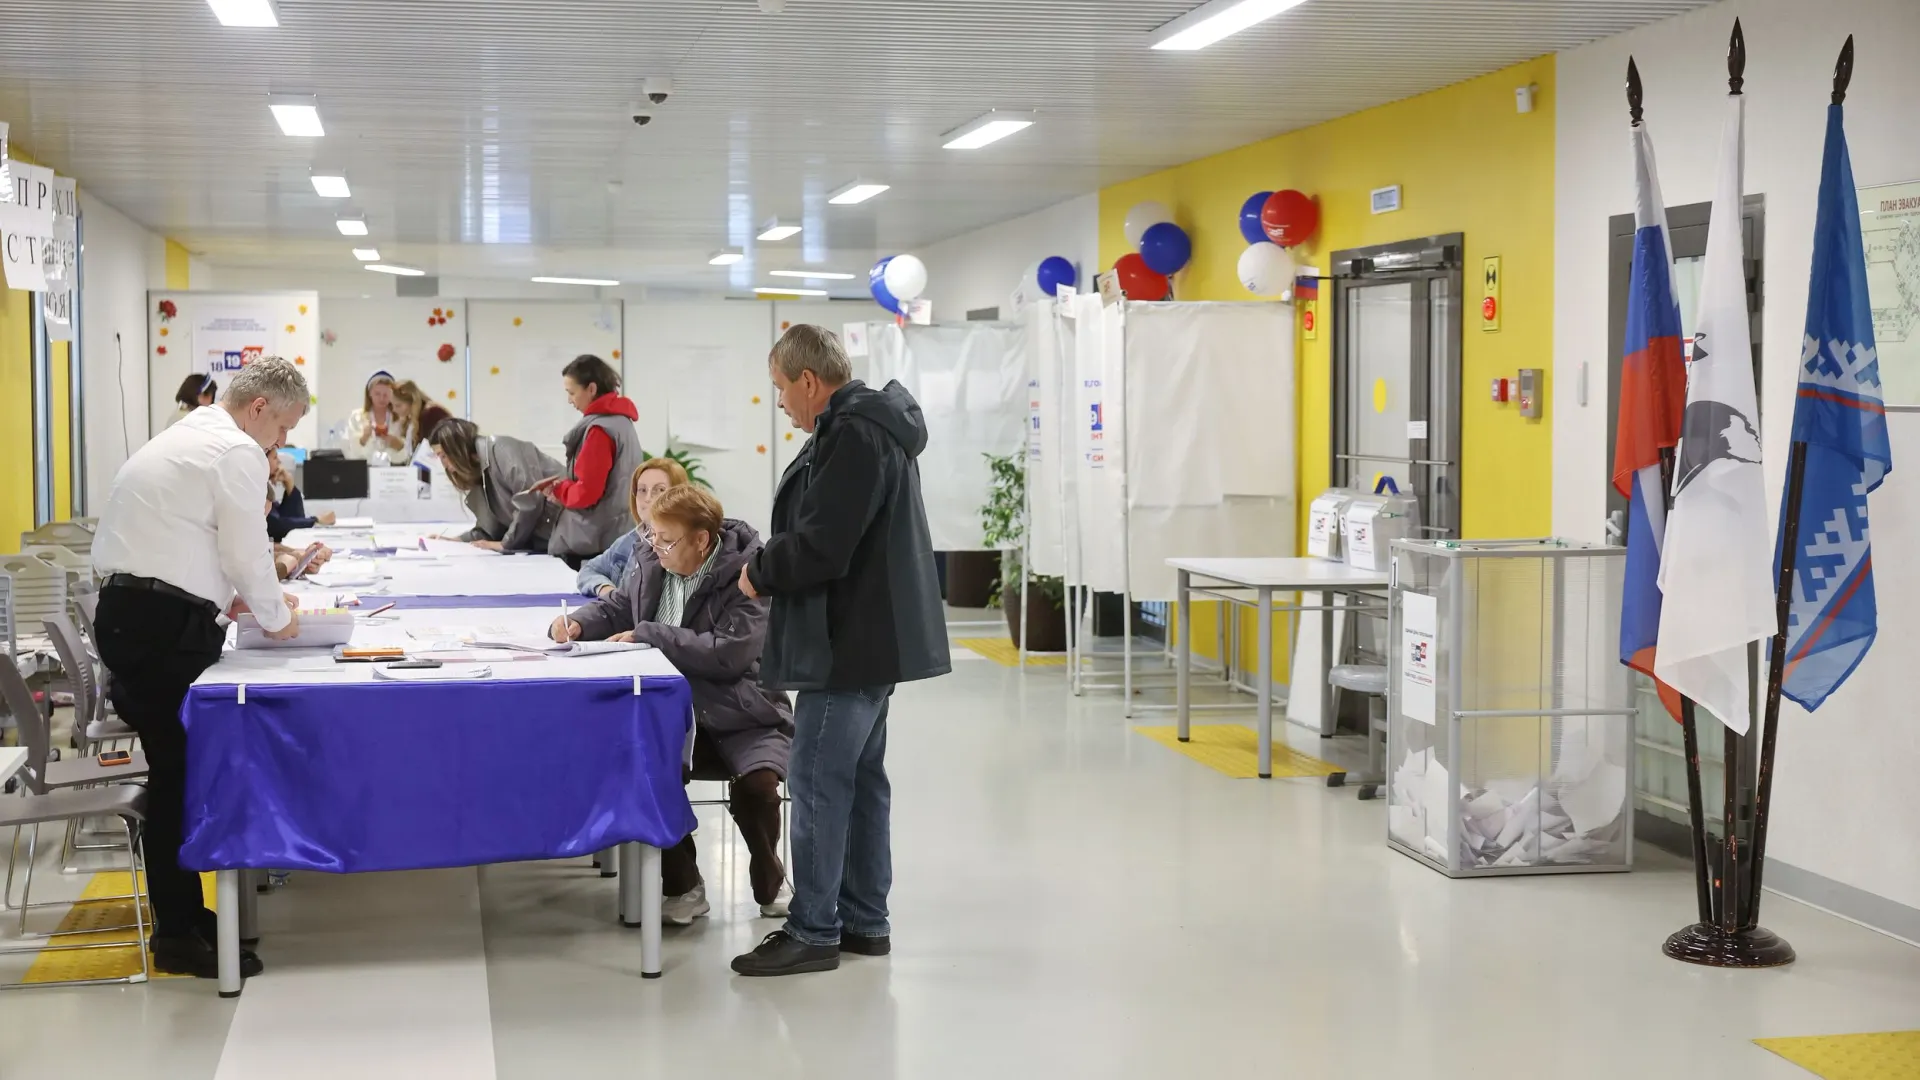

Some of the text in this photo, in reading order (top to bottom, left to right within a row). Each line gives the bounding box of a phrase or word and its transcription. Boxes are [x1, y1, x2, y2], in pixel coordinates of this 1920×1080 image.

[17, 177, 47, 209] П Р
[1881, 200, 1897, 212] ПЛАН
[7, 233, 37, 264] С Т
